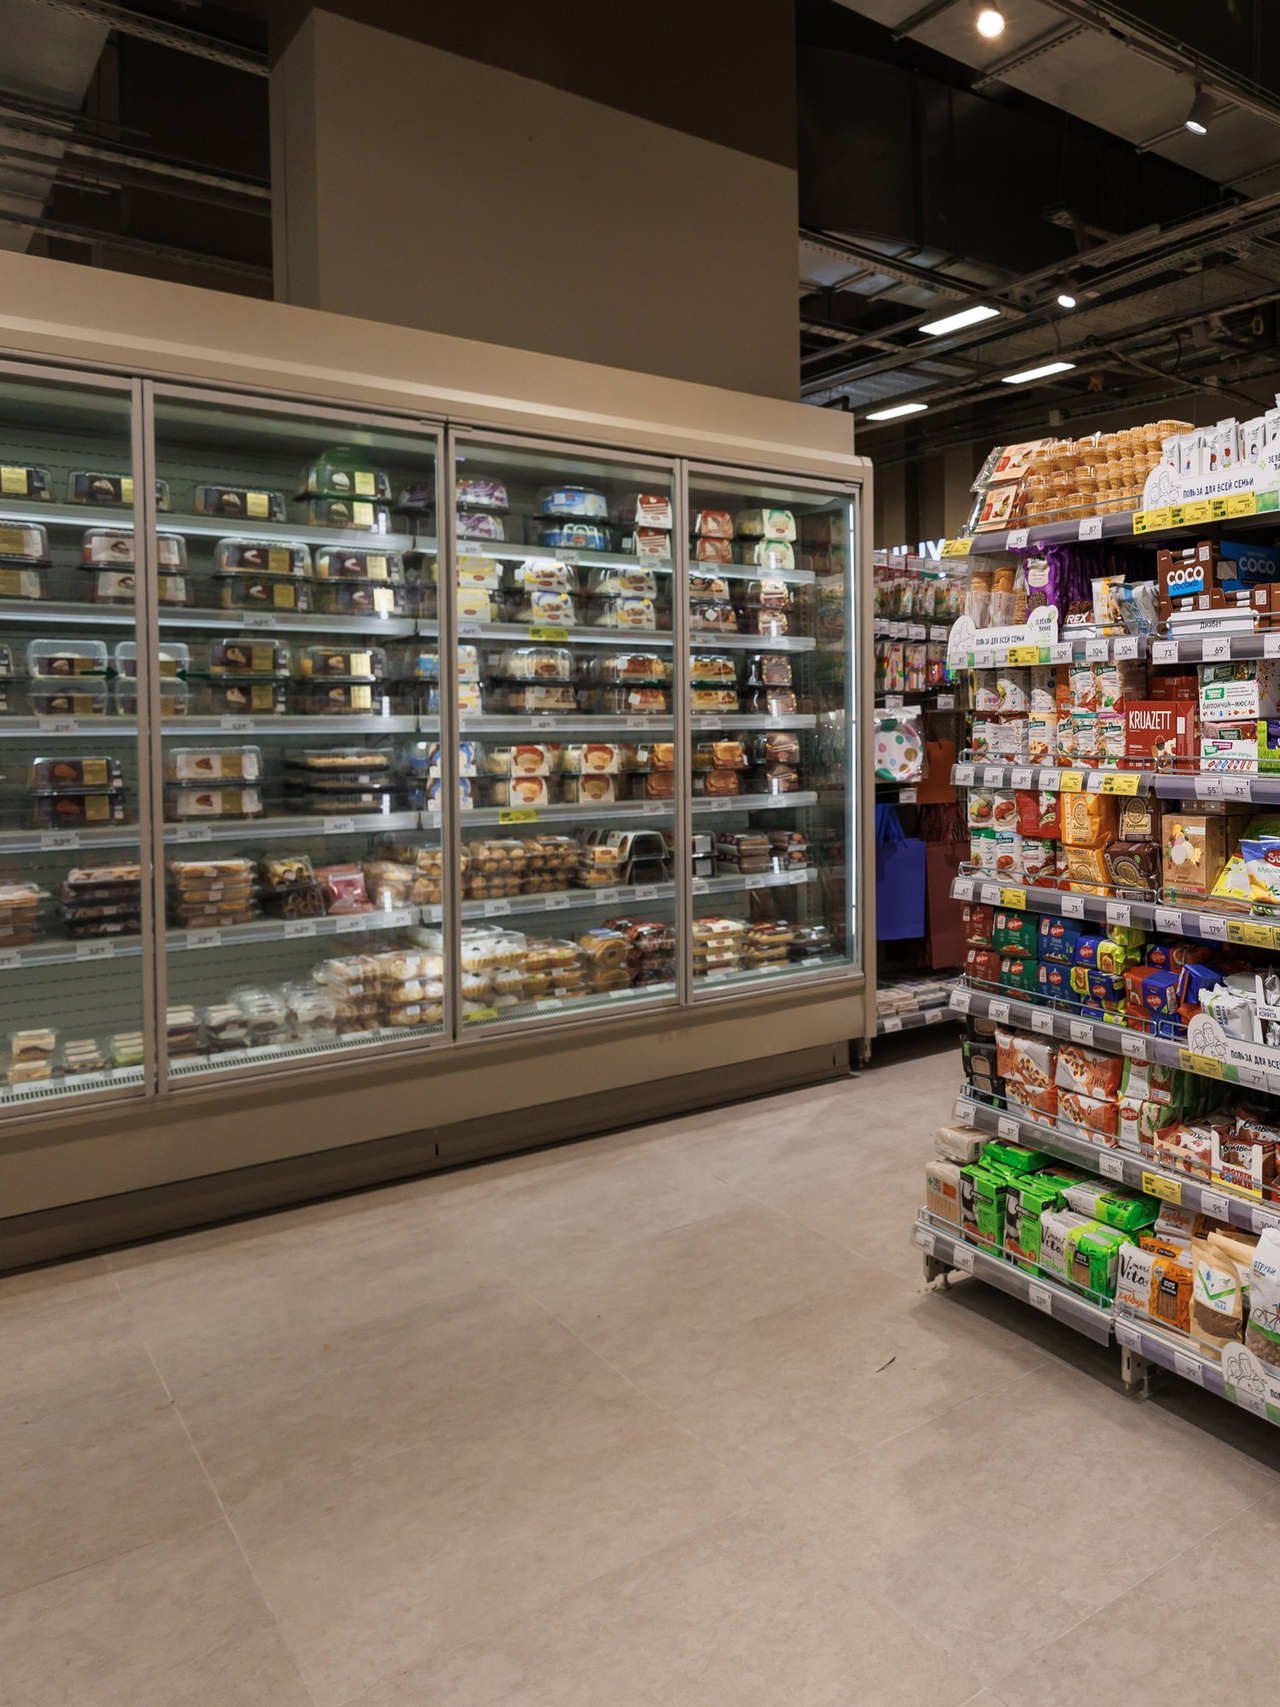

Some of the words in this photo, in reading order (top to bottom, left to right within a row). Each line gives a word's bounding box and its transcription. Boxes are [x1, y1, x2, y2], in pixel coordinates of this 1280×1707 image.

[1183, 488, 1204, 499] ПОЛЬЗА
[1205, 486, 1216, 496] ДЛЯ
[1217, 482, 1233, 493] ВСЕЙ
[1234, 478, 1254, 490] СЕМЬИ
[1239, 557, 1276, 574] COCO
[1167, 565, 1204, 585] COCO
[1066, 612, 1089, 624] REX
[1200, 621, 1221, 630] Диабет
[1092, 647, 1103, 655] 104
[1121, 645, 1132, 653] 104
[1215, 647, 1224, 655] 69
[1057, 650, 1067, 658] 109
[1129, 710, 1171, 730] KRUAZETT
[1235, 787, 1243, 795] 33
[1164, 919, 1176, 927] 164
[1209, 925, 1221, 933] 179
[1230, 1050, 1252, 1063] ПОЛЬЗА
[1254, 1055, 1266, 1065] ДЛЯ
[1222, 1165, 1252, 1180] PROTEIN
[1213, 1204, 1222, 1213] 95
[1253, 1260, 1277, 1276] ОТРУБИ
